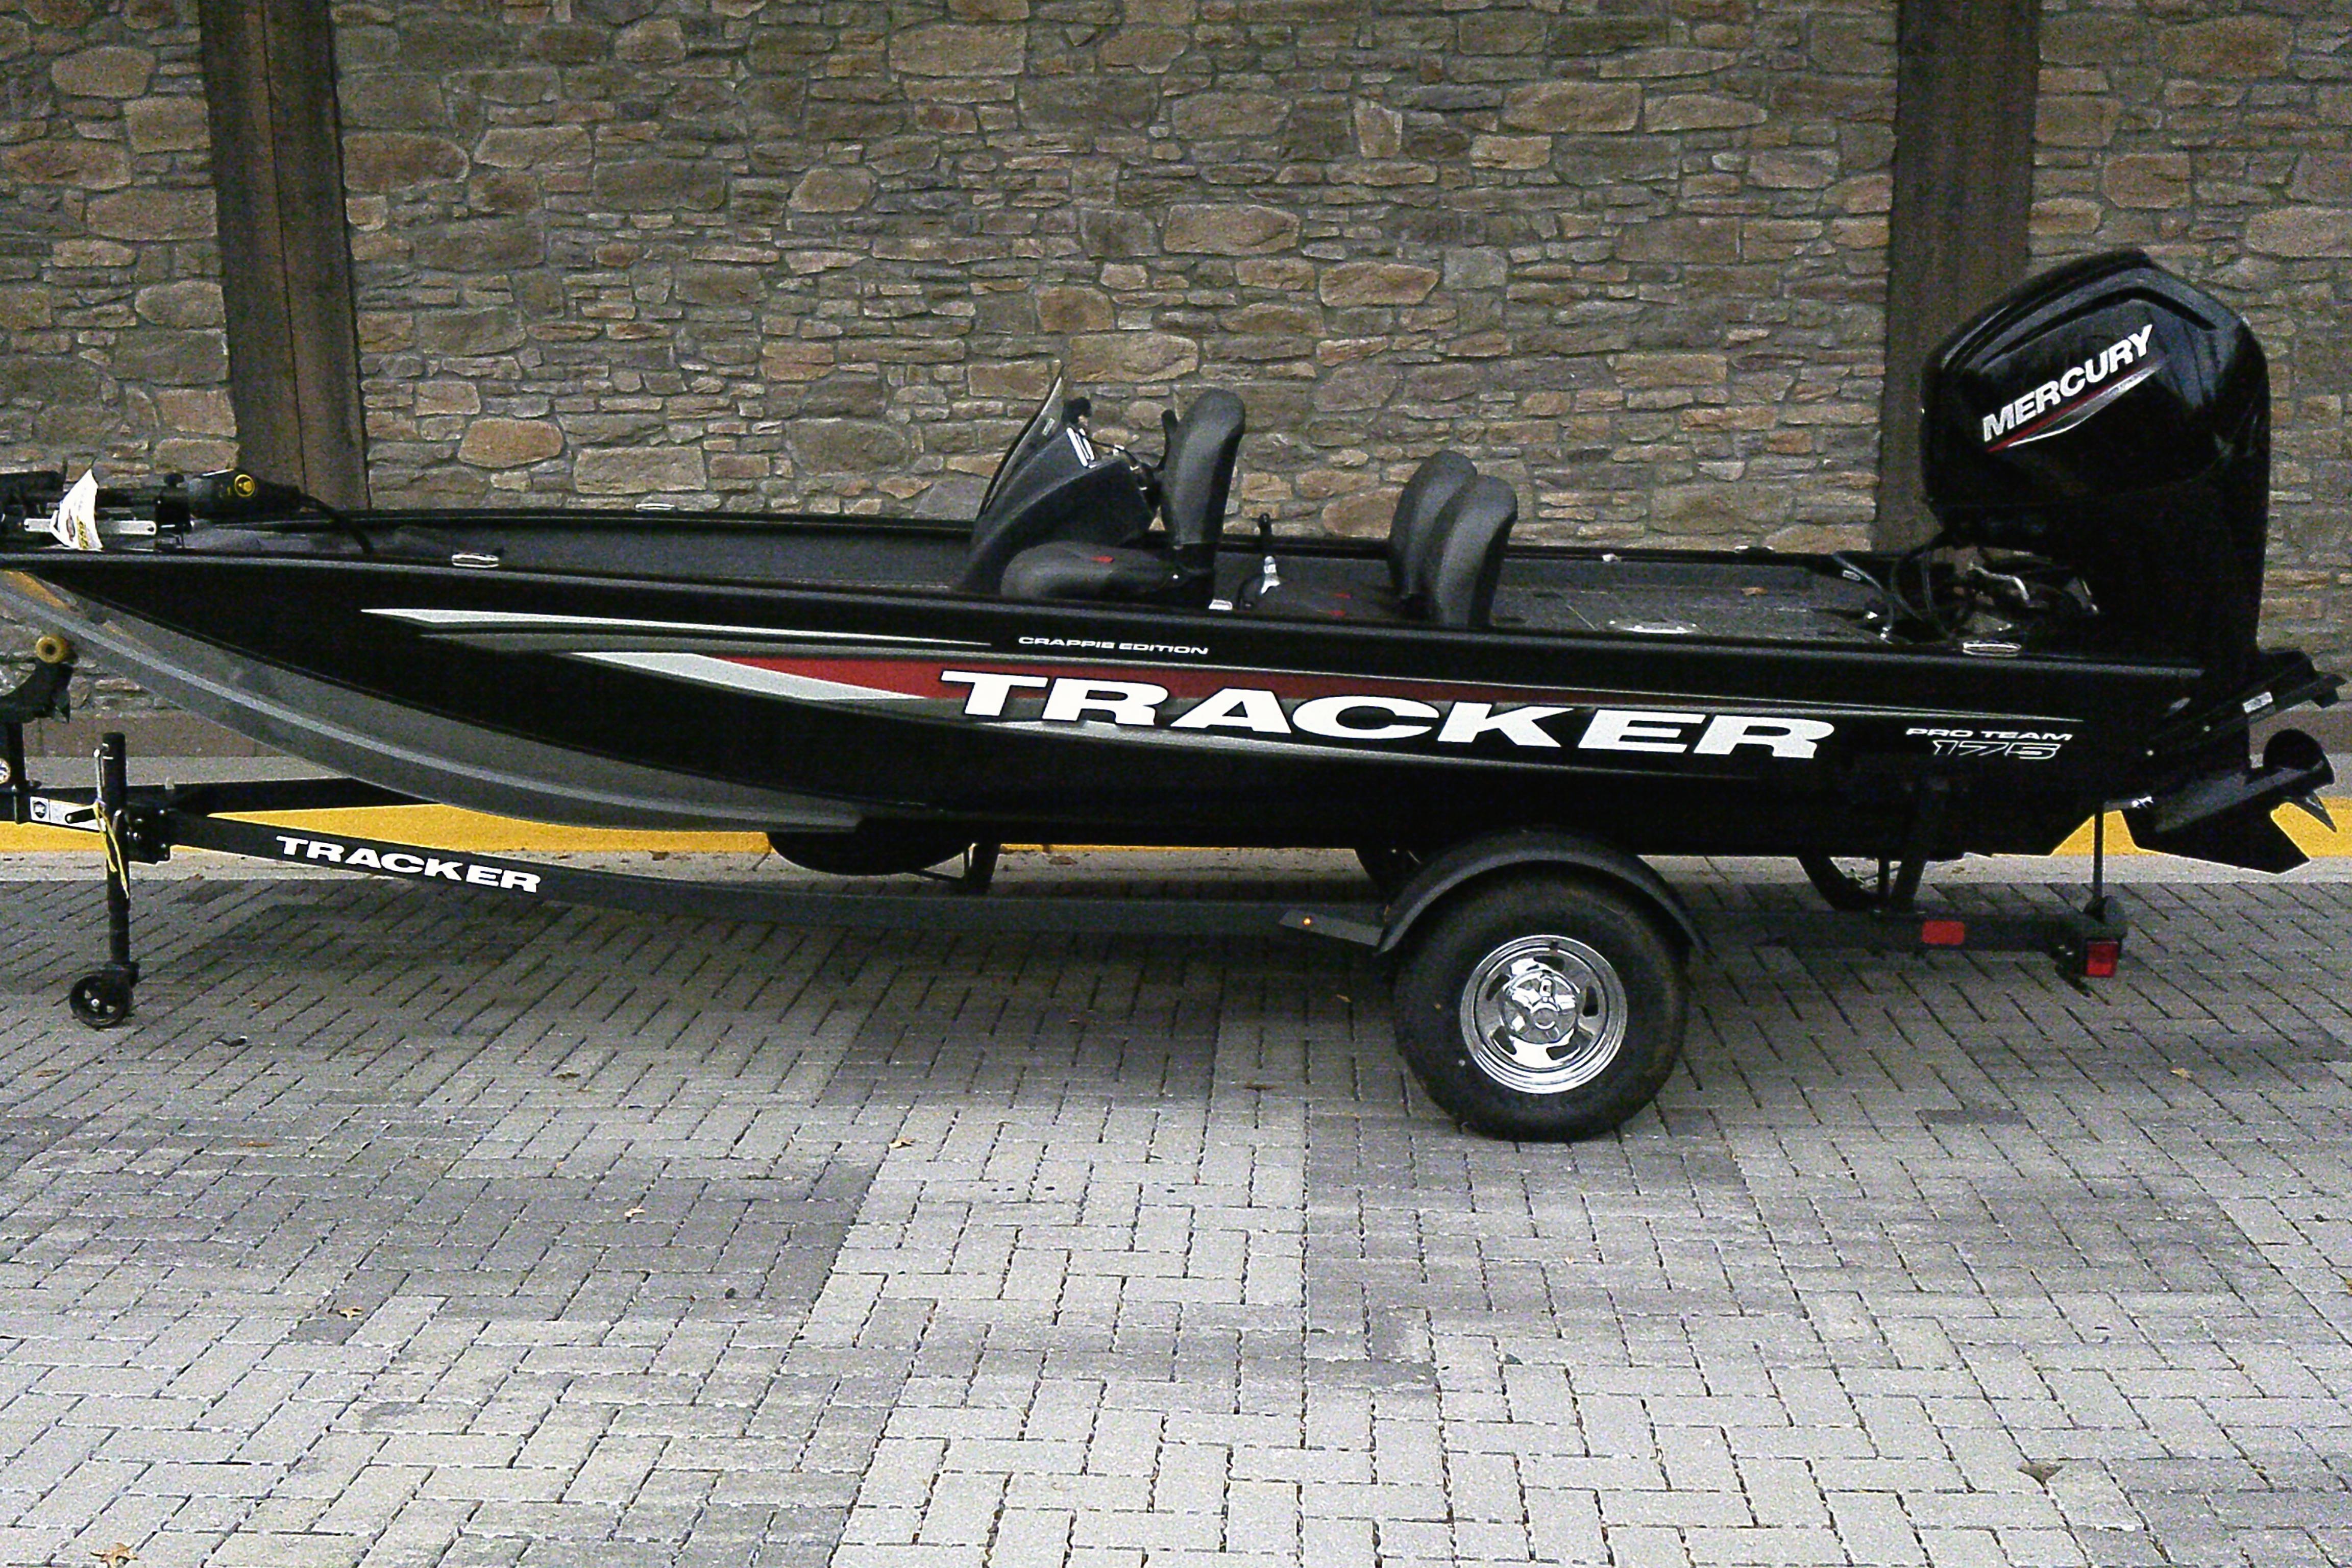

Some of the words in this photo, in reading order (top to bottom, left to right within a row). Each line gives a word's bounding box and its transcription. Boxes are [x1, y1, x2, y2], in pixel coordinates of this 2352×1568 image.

[1982, 324, 2153, 443] MERCURY
[1018, 636, 1115, 649] CRAPPIE
[1118, 642, 1209, 655] EDITION
[940, 670, 1835, 759] TRACKER
[1906, 728, 1974, 737] PRO
[1981, 731, 2073, 741] TEAM
[1932, 740, 2062, 760] 175
[276, 836, 541, 893] TRACKER
